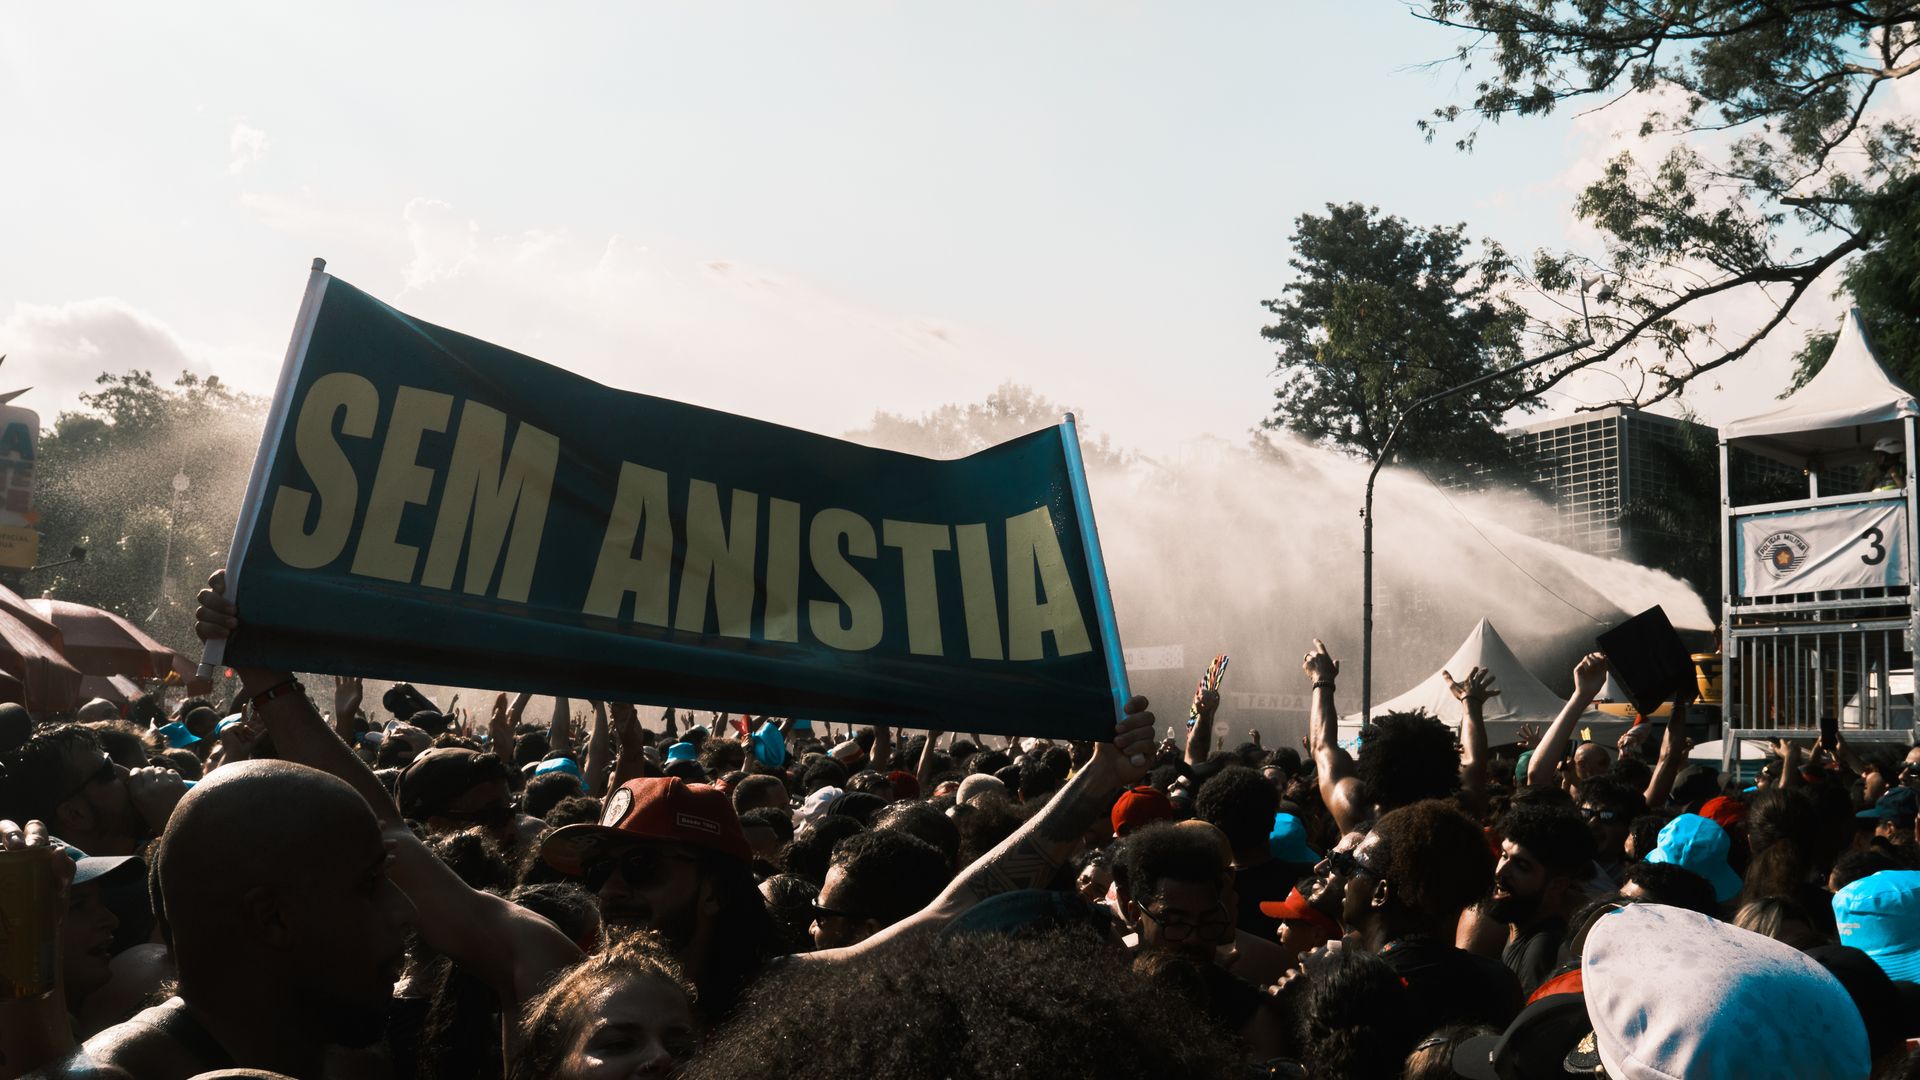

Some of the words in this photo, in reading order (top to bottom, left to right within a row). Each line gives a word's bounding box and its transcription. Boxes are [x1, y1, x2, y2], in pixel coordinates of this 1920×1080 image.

[269, 372, 560, 603] SEM
[583, 462, 1092, 661] ANISTIA
[1783, 533, 1806, 551] MILITAR
[1861, 527, 1886, 565] 3
[1248, 694, 1305, 708] TENDA
